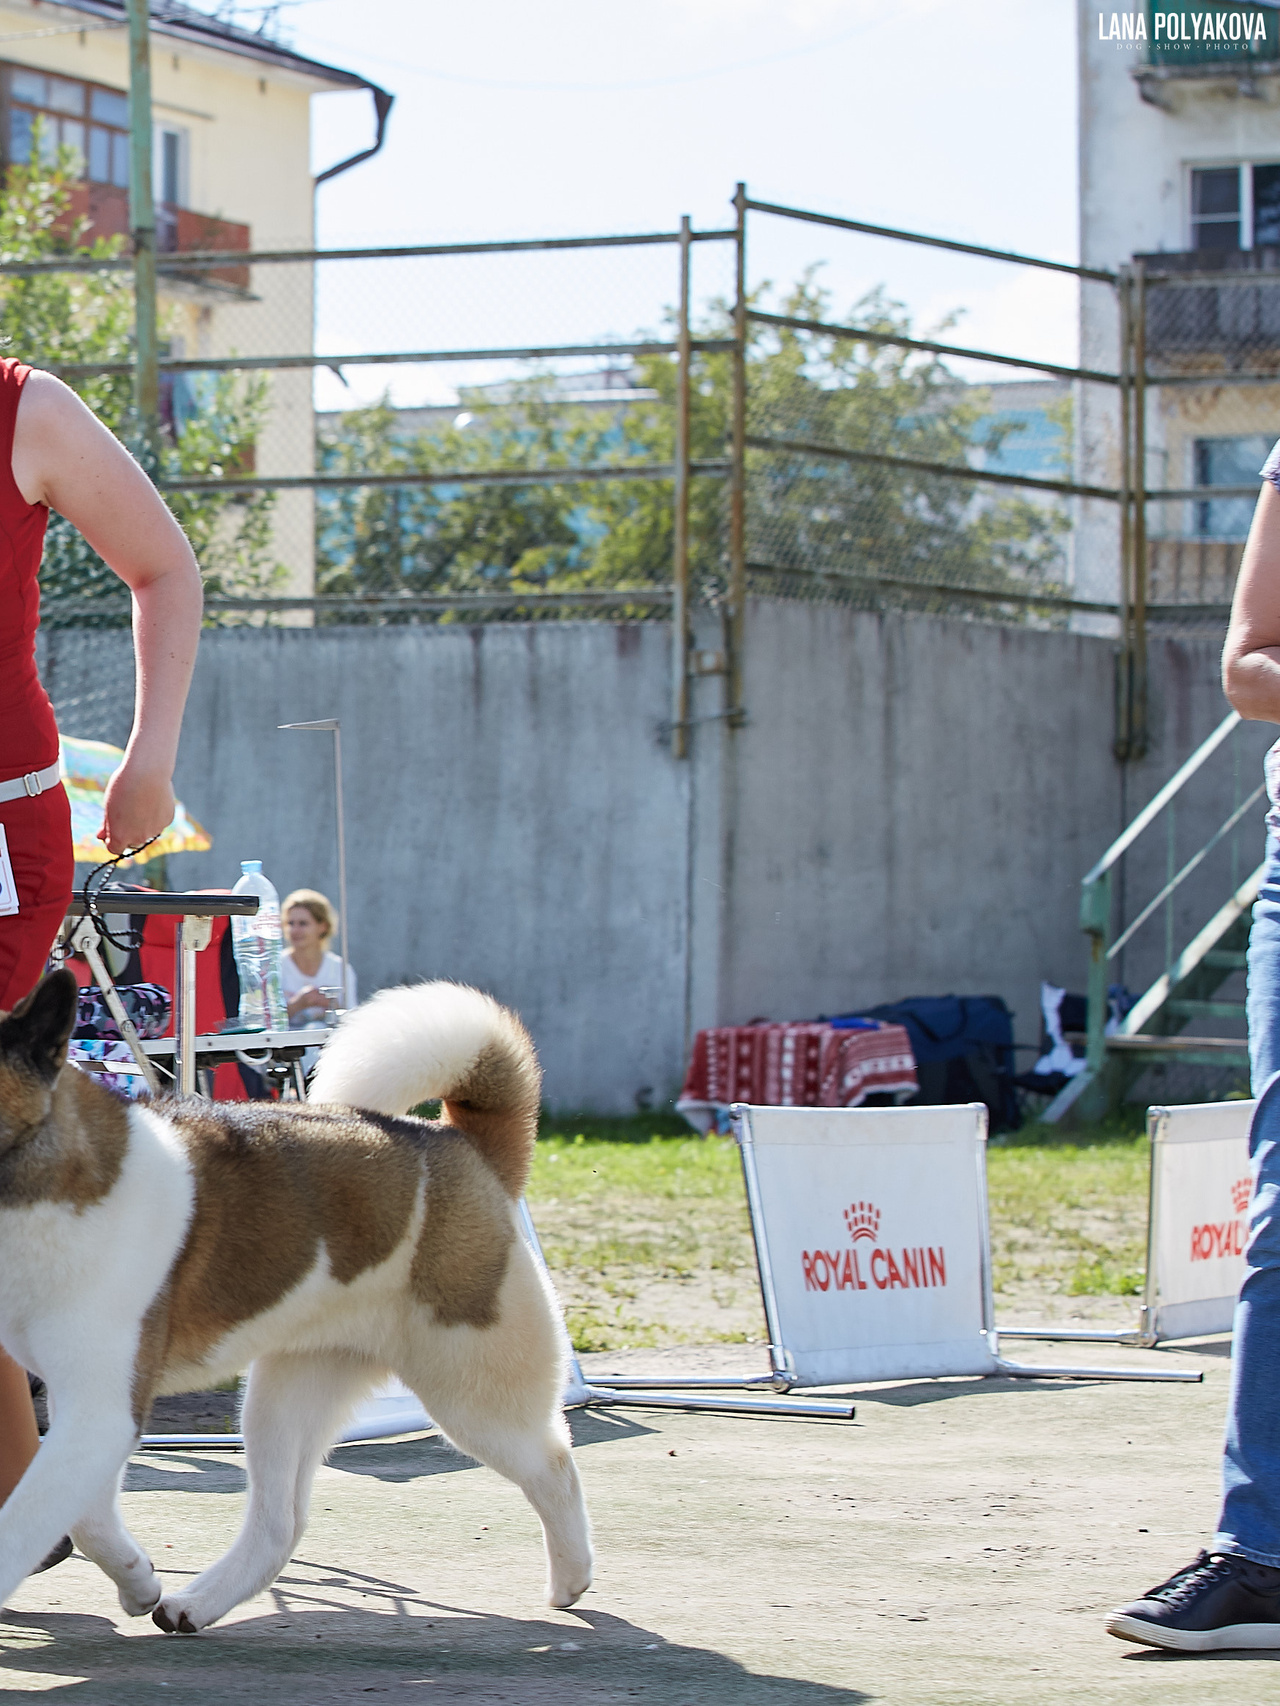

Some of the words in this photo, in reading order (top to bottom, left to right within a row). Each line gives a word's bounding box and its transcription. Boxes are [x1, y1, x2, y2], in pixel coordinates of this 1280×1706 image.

[1190, 1220, 1243, 1262] ROYAL
[801, 1249, 868, 1292] ROYAL
[871, 1246, 947, 1290] CANIN
